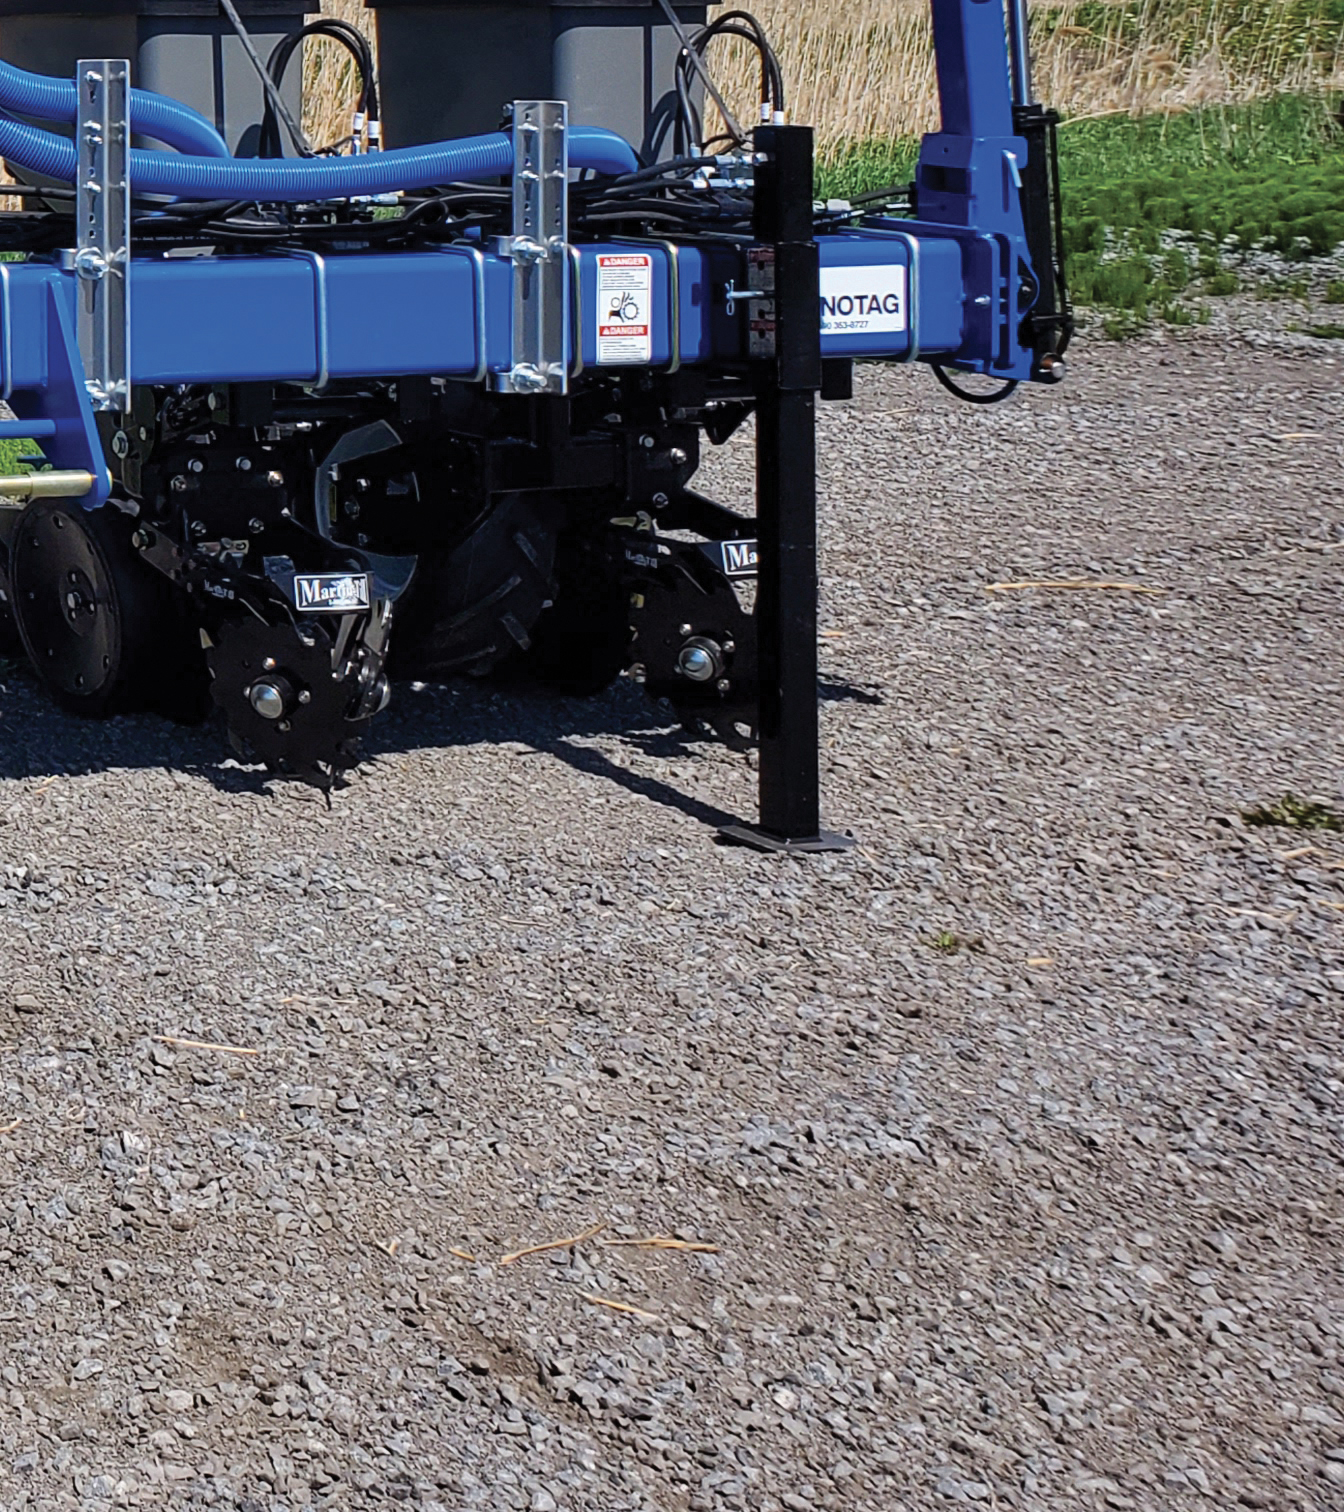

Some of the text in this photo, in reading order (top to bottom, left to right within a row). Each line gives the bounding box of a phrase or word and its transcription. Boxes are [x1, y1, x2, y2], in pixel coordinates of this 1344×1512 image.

[610, 258, 645, 266] DANGER
[820, 293, 899, 316] NOTAG
[609, 326, 645, 335] DANGER
